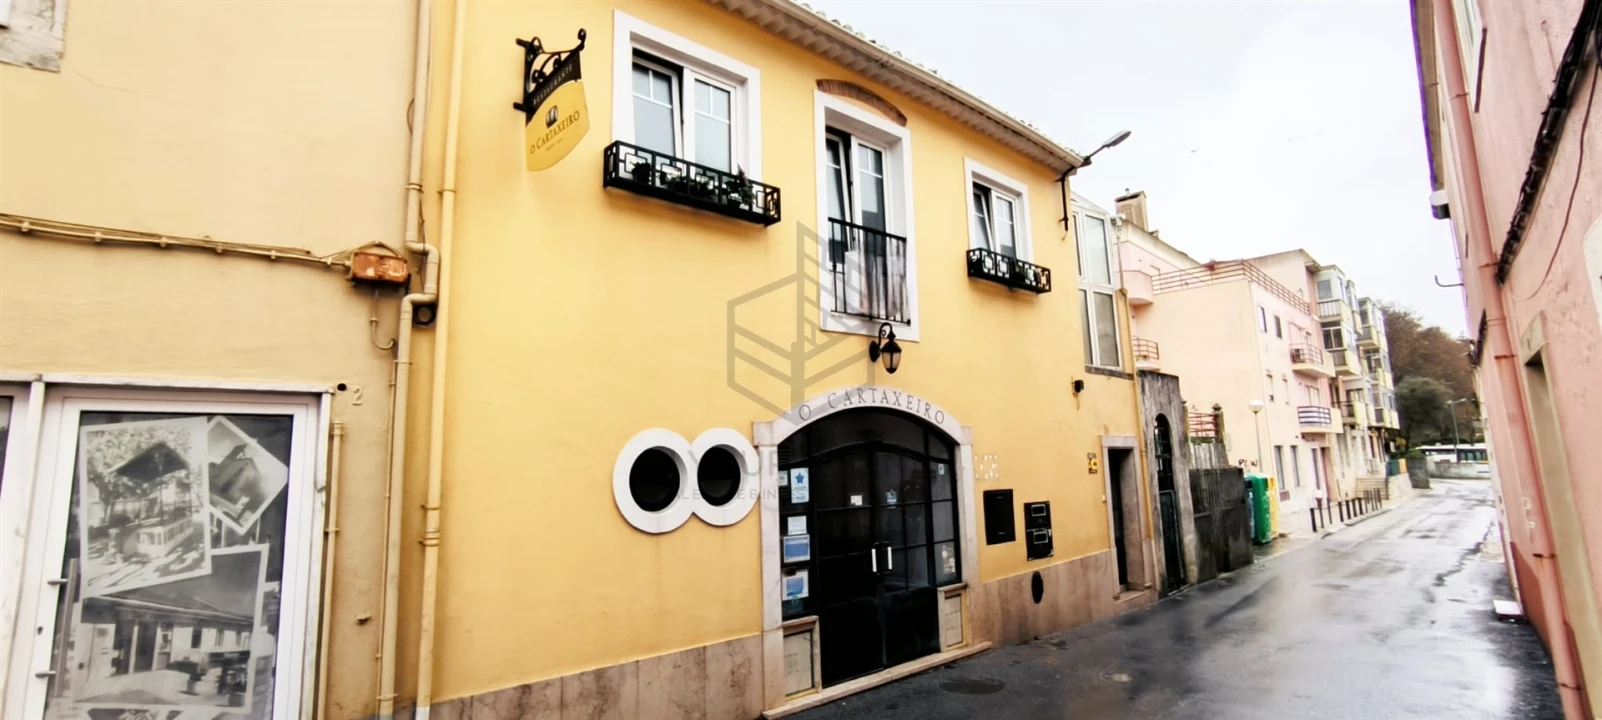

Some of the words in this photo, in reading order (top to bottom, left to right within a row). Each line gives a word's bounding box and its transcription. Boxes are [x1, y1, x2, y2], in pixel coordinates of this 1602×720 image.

[529, 145, 536, 155] O
[536, 110, 580, 150] CARTAXEIRO
[352, 386, 363, 406] 2
[798, 404, 812, 421] O
[827, 387, 945, 425] CARTAXEIRO
